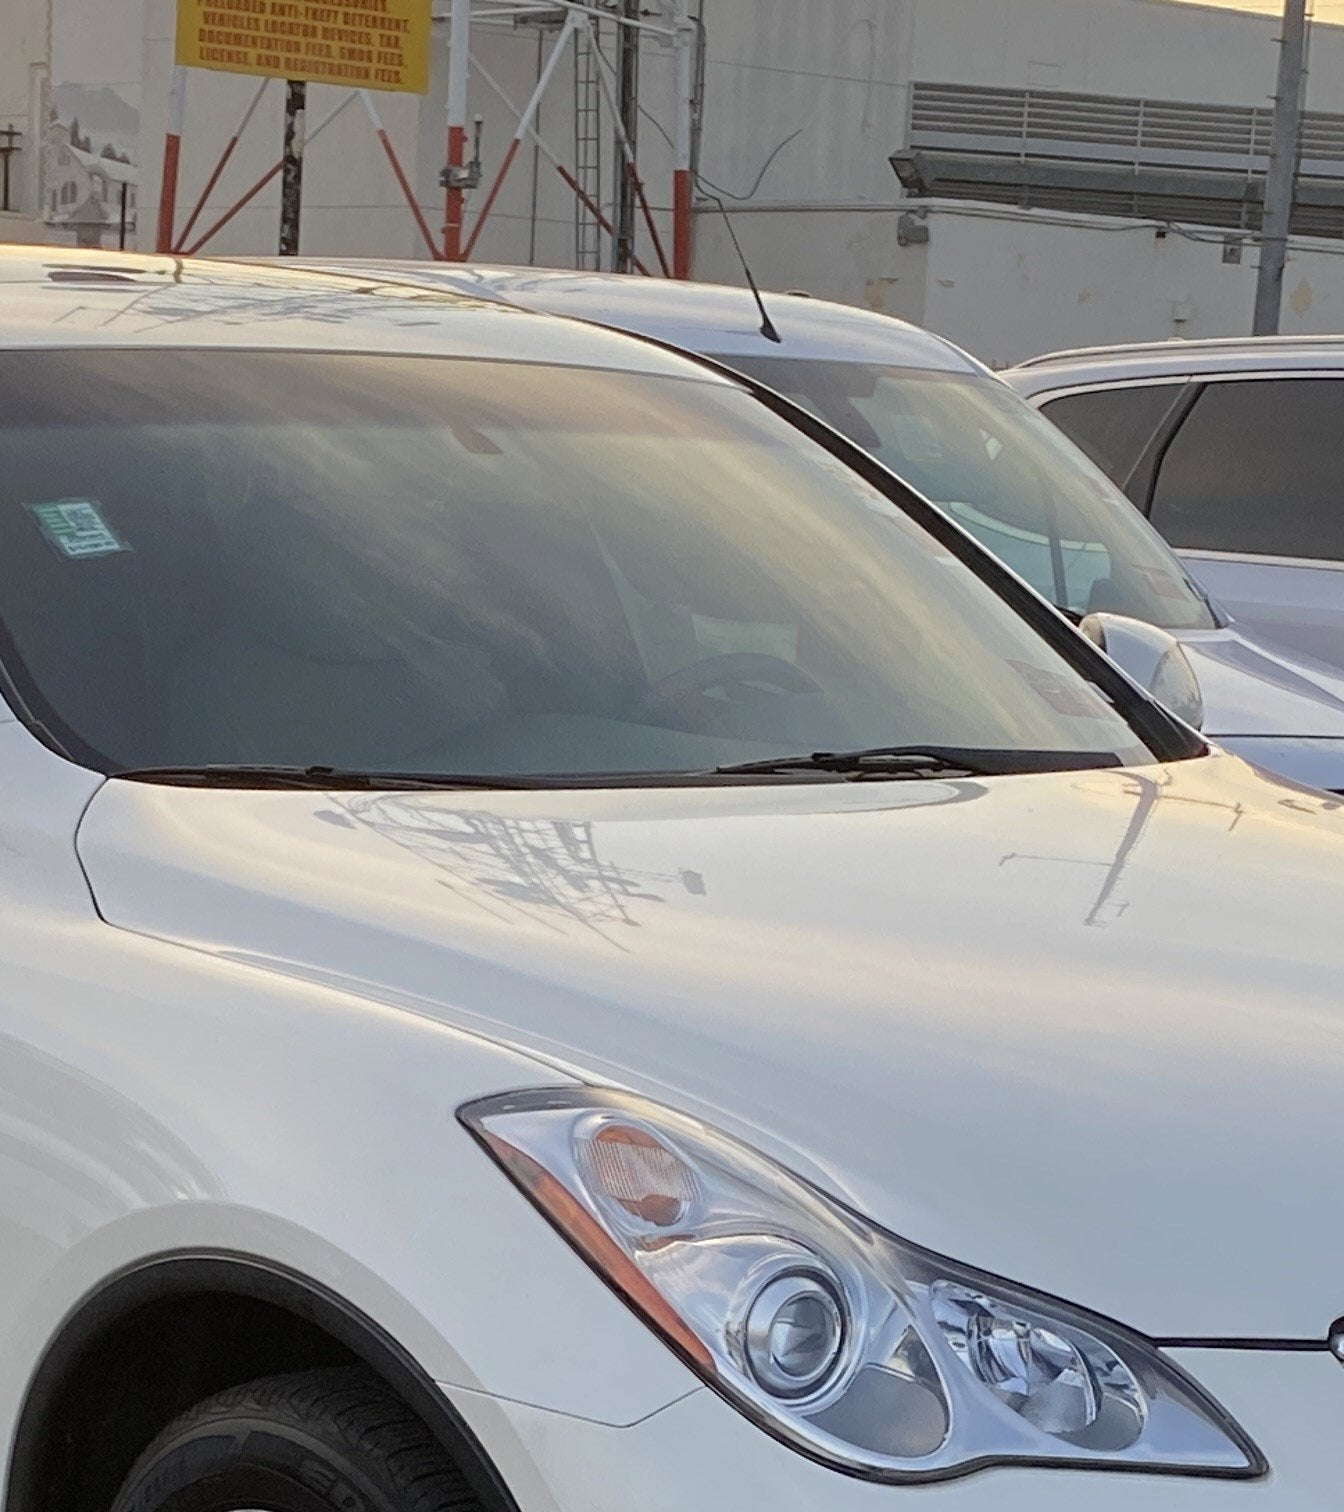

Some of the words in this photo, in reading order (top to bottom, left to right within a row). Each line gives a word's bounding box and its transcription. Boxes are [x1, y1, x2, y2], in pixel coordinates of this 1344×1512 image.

[203, 11, 260, 31] VEHICLES
[264, 19, 318, 38] LOCATOR
[270, 2, 338, 24] ANTI-THEFT
[198, 28, 301, 54] DOCUMENTATION
[339, 46, 373, 63] SMOG
[257, 53, 280, 68] AND
[284, 57, 369, 80] REGISTRATION
